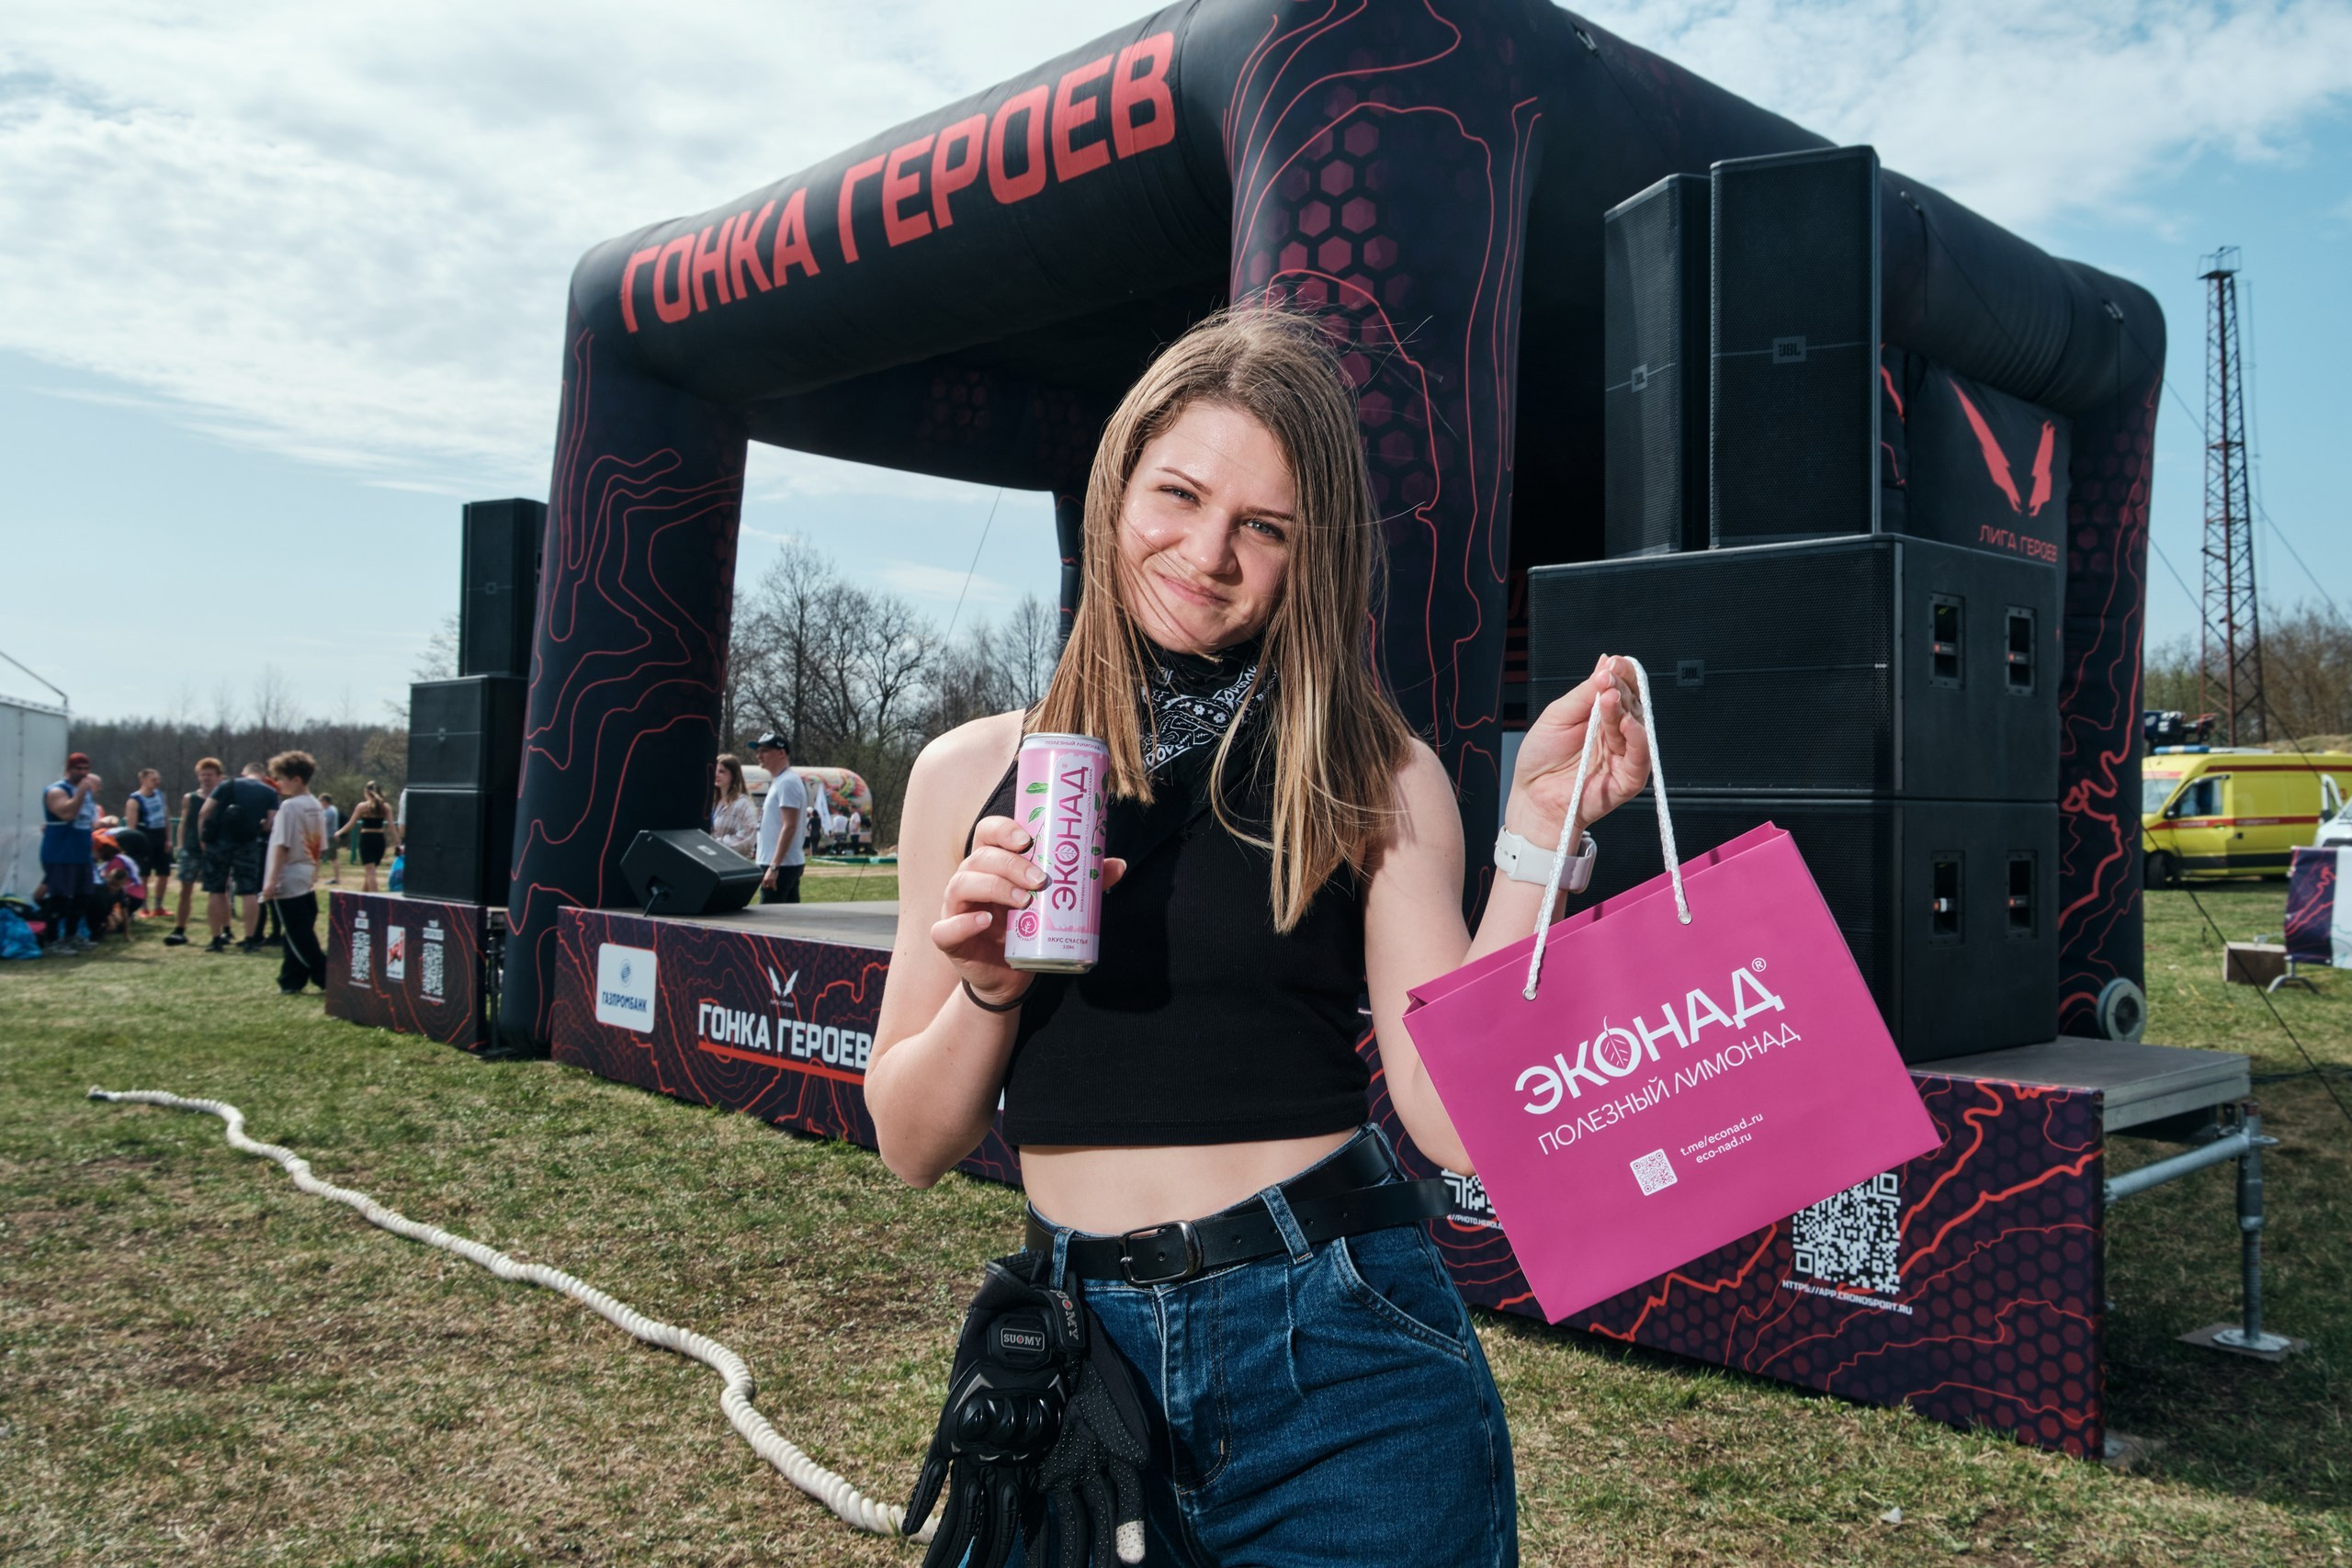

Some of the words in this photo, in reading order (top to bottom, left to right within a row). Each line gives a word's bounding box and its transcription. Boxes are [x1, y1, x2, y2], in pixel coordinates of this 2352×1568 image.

[621, 187, 820, 333] ГОНКА
[837, 31, 1176, 264] ГЕРОЕВ
[1779, 343, 1801, 357] JBL
[1979, 525, 2017, 552] ЛИГА
[2019, 536, 2058, 562] ГЕРОЕВ
[602, 991, 648, 1012] ГАЗПРОМБАНК
[698, 1003, 771, 1050] ГОНКА
[777, 1018, 872, 1070] ГЕРОЕВ
[1538, 1077, 1670, 1156] ПОЛЕЗНЫЙ
[1674, 1022, 1802, 1100] ЛИМОНАД
[1679, 1112, 1764, 1156] t.me/econad_ru
[1695, 1133, 1752, 1164] eco-nad.ru
[1049, 1290, 1080, 1340] UOMY
[1782, 1280, 1913, 1315] HTTPS://APP.CRONOSPORT.RU
[1003, 1333, 1043, 1348] SUOMY
